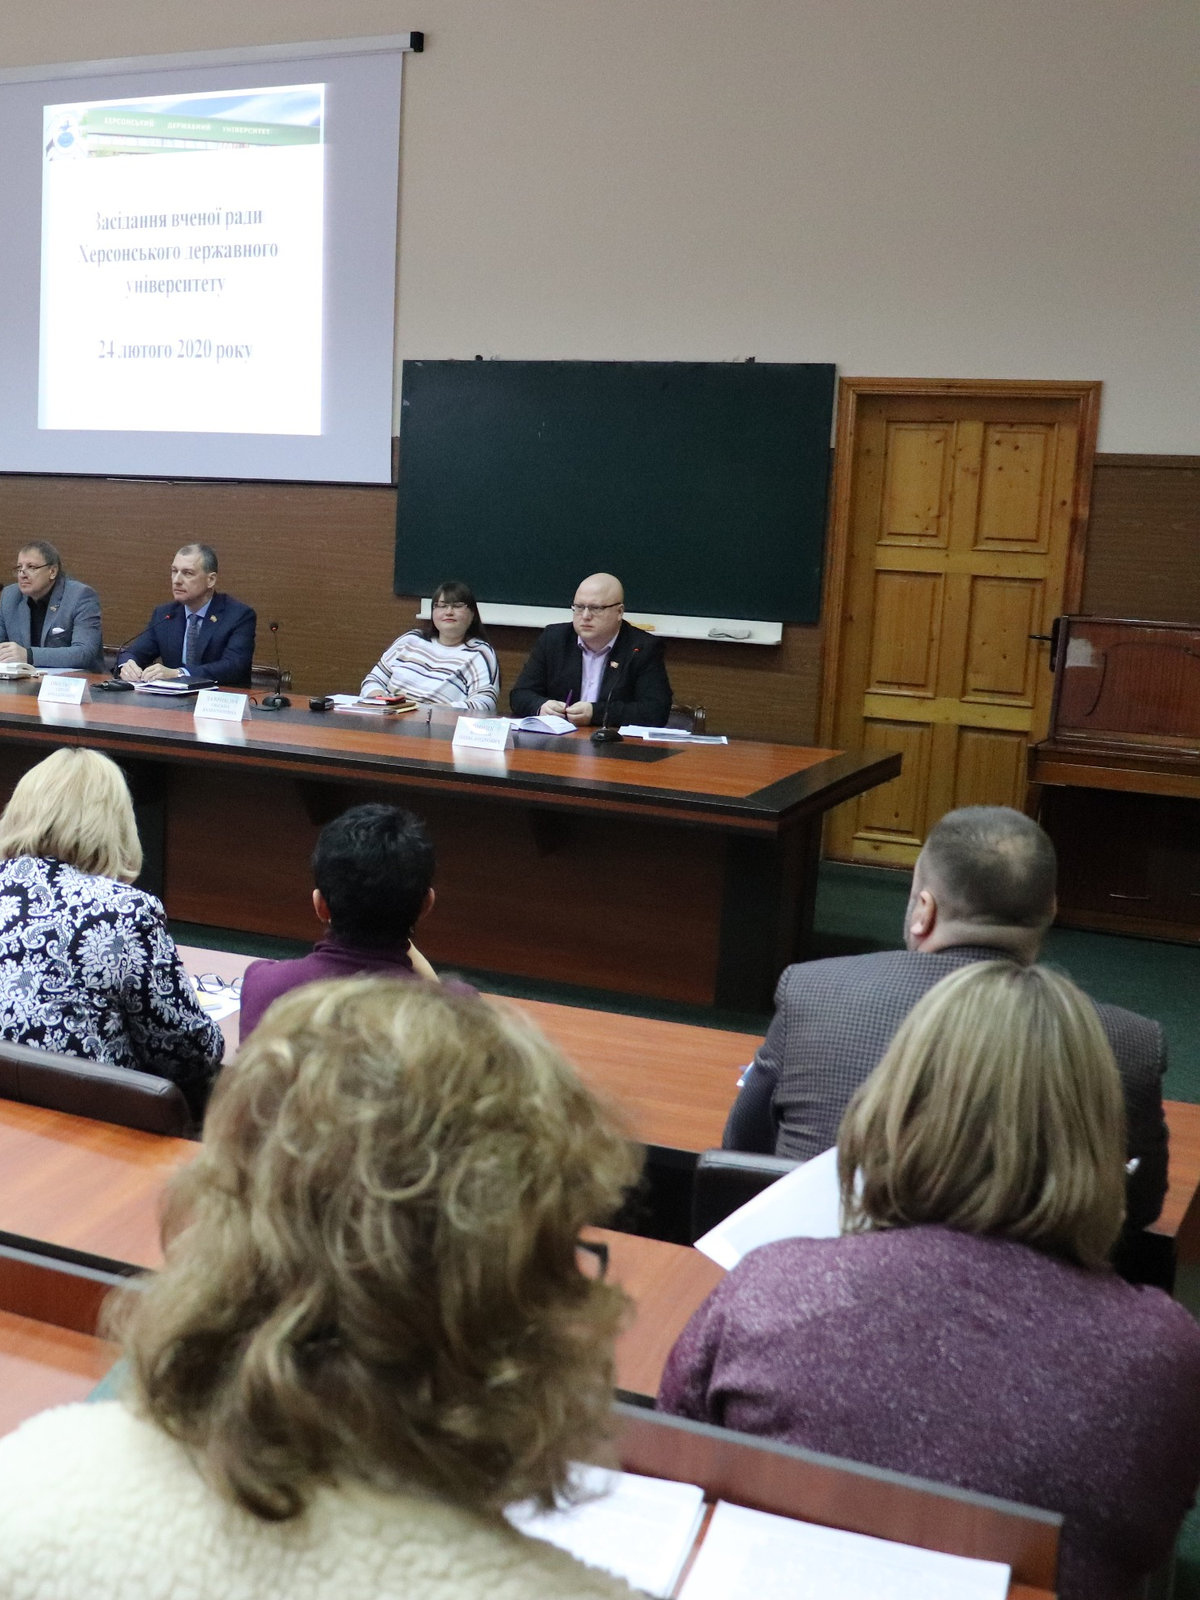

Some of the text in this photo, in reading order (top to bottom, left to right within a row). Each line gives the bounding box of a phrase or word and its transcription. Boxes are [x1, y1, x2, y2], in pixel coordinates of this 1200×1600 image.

[171, 207, 222, 227] вченої
[225, 209, 262, 230] ради
[98, 338, 253, 364] 24 лютого 2020 року
